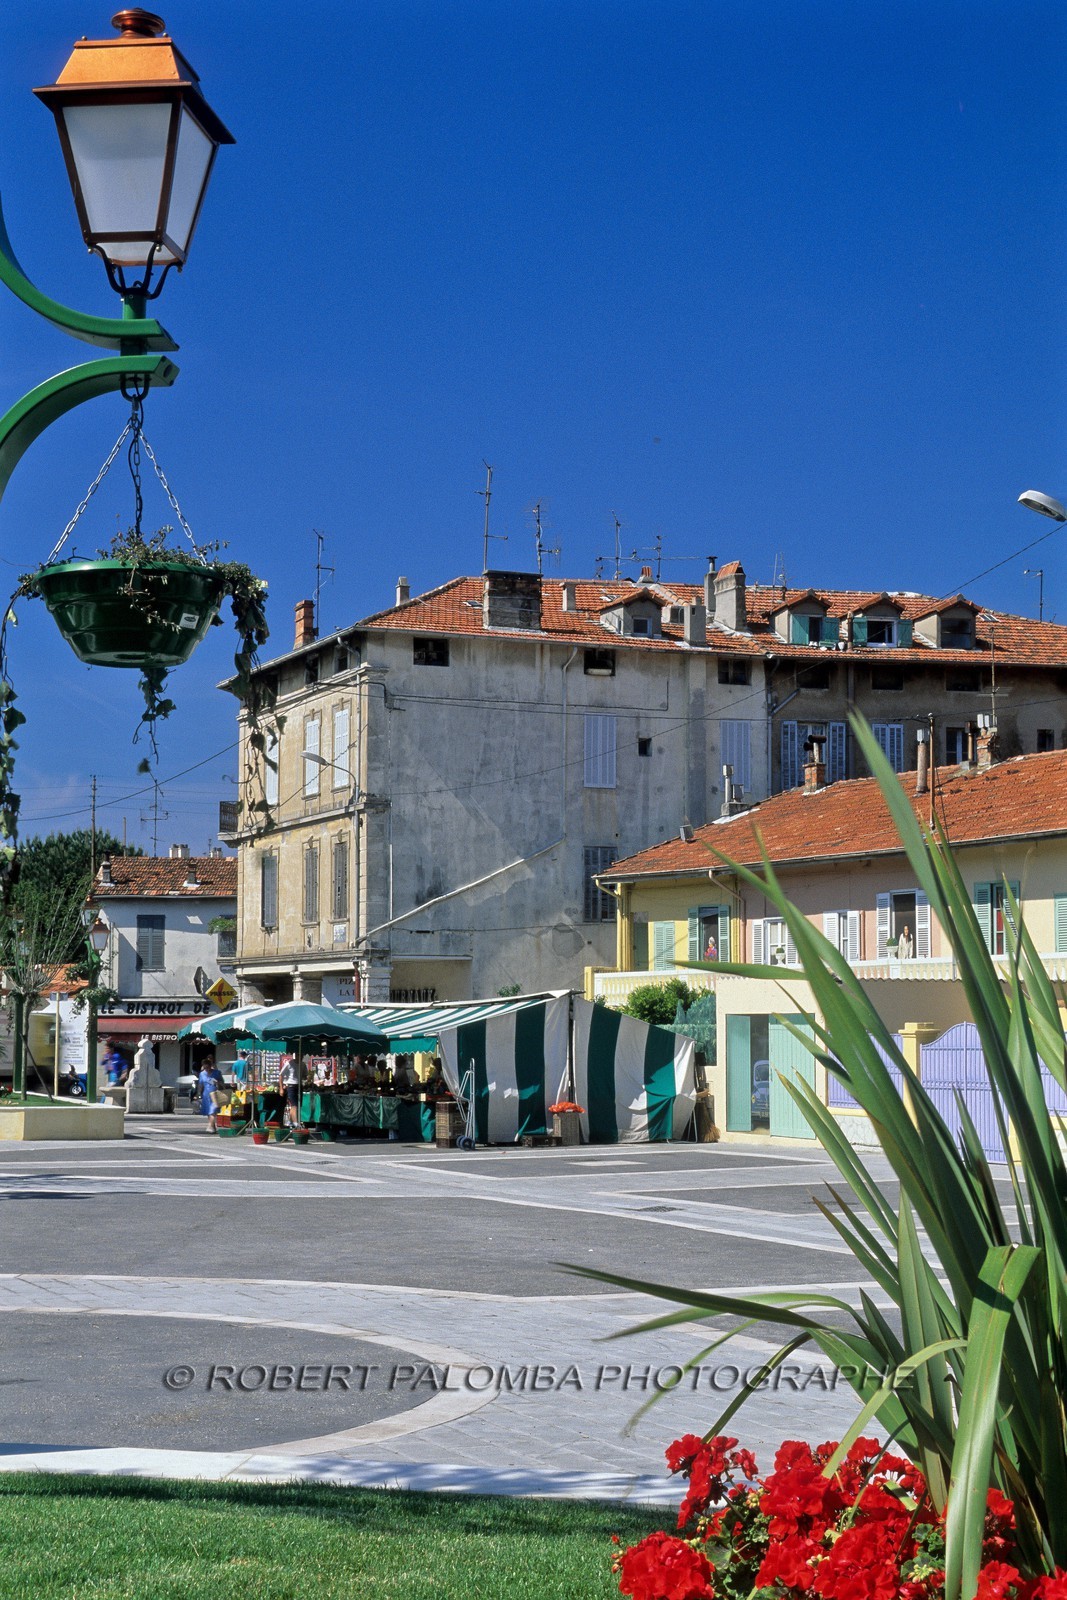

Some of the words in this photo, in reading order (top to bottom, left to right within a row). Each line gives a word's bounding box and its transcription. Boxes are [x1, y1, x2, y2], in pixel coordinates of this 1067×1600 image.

[101, 1002, 115, 1014] LE
[127, 1002, 184, 1015] BISTROT
[193, 1002, 211, 1014] DE
